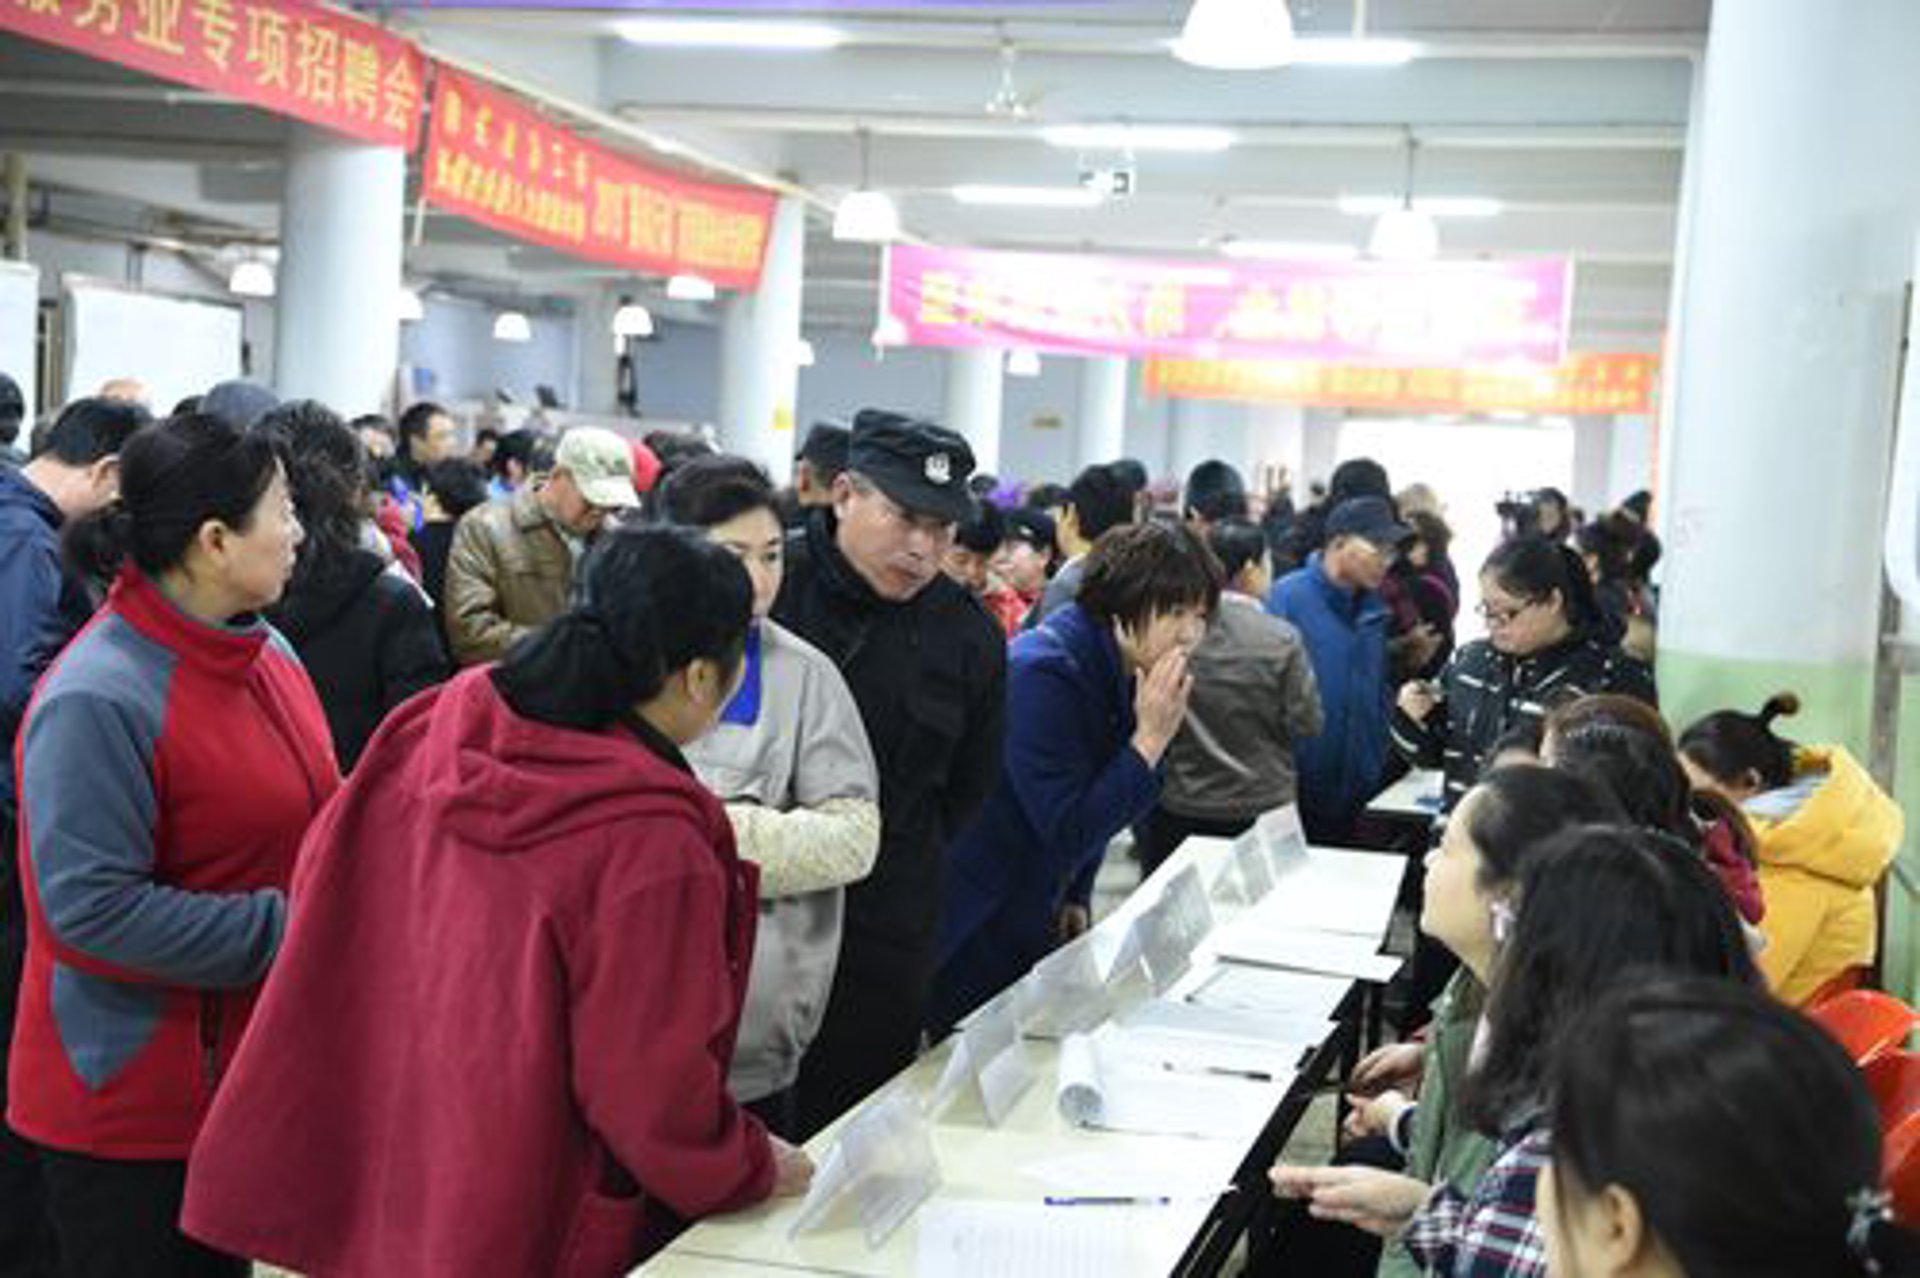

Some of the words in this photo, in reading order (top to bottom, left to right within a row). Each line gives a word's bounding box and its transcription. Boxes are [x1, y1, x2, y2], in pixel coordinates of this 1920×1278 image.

[14, 0, 417, 130] 业专项招聘会
